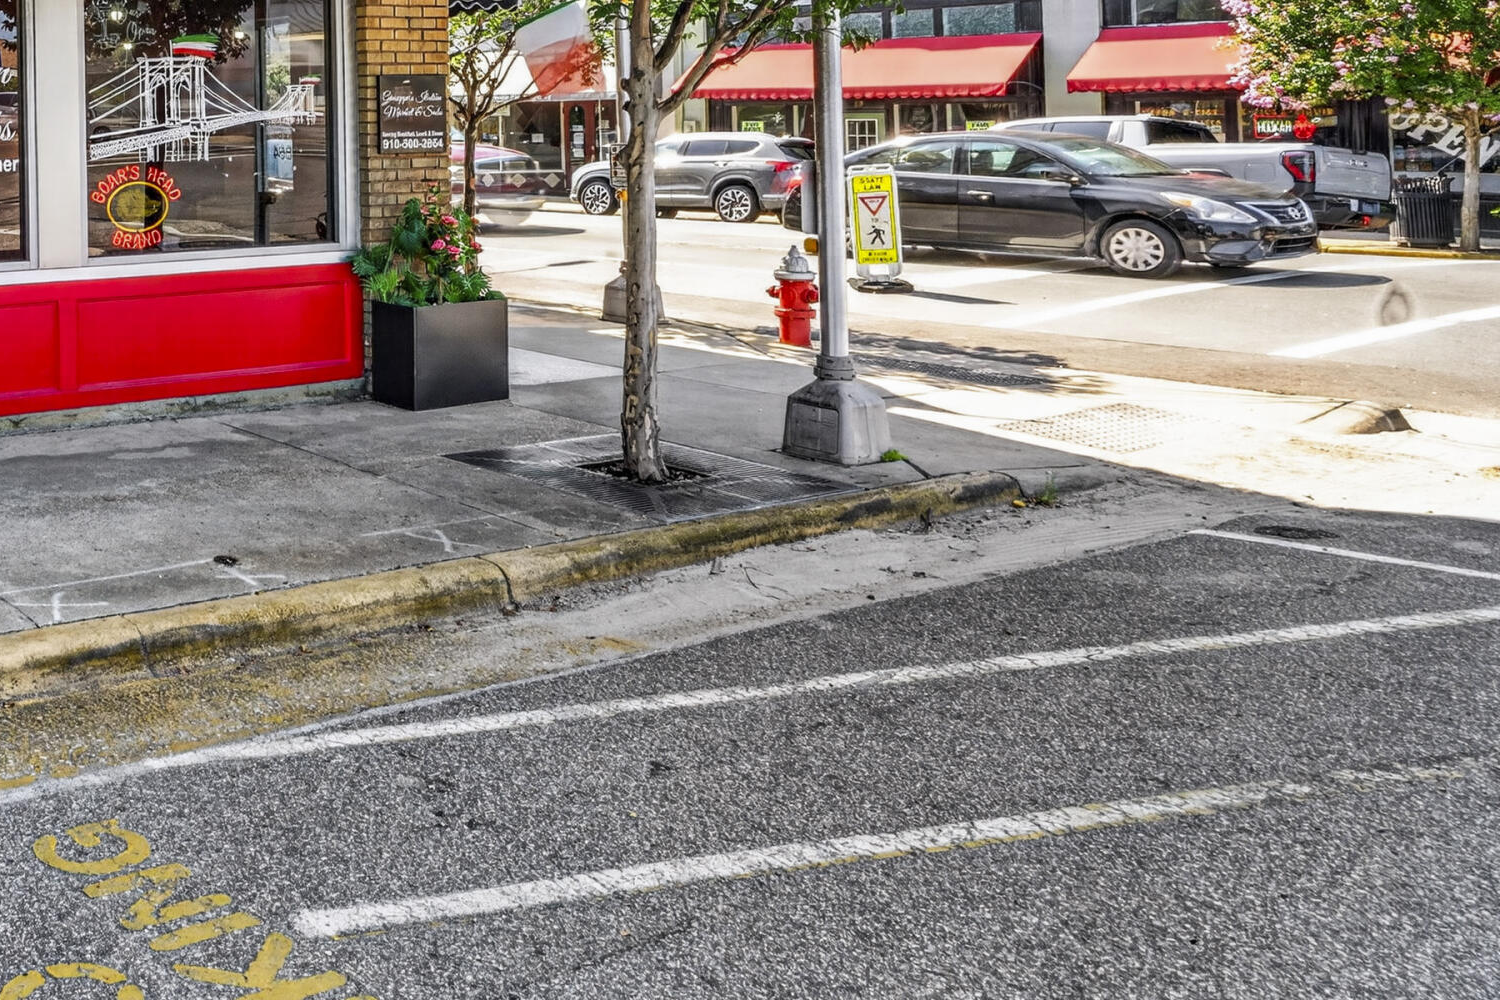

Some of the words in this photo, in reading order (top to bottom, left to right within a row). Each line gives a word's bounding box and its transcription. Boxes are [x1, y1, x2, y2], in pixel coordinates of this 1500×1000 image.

[91, 165, 140, 204] BOAR'S
[148, 166, 182, 201] HEAD
[112, 230, 161, 249] BRAND
